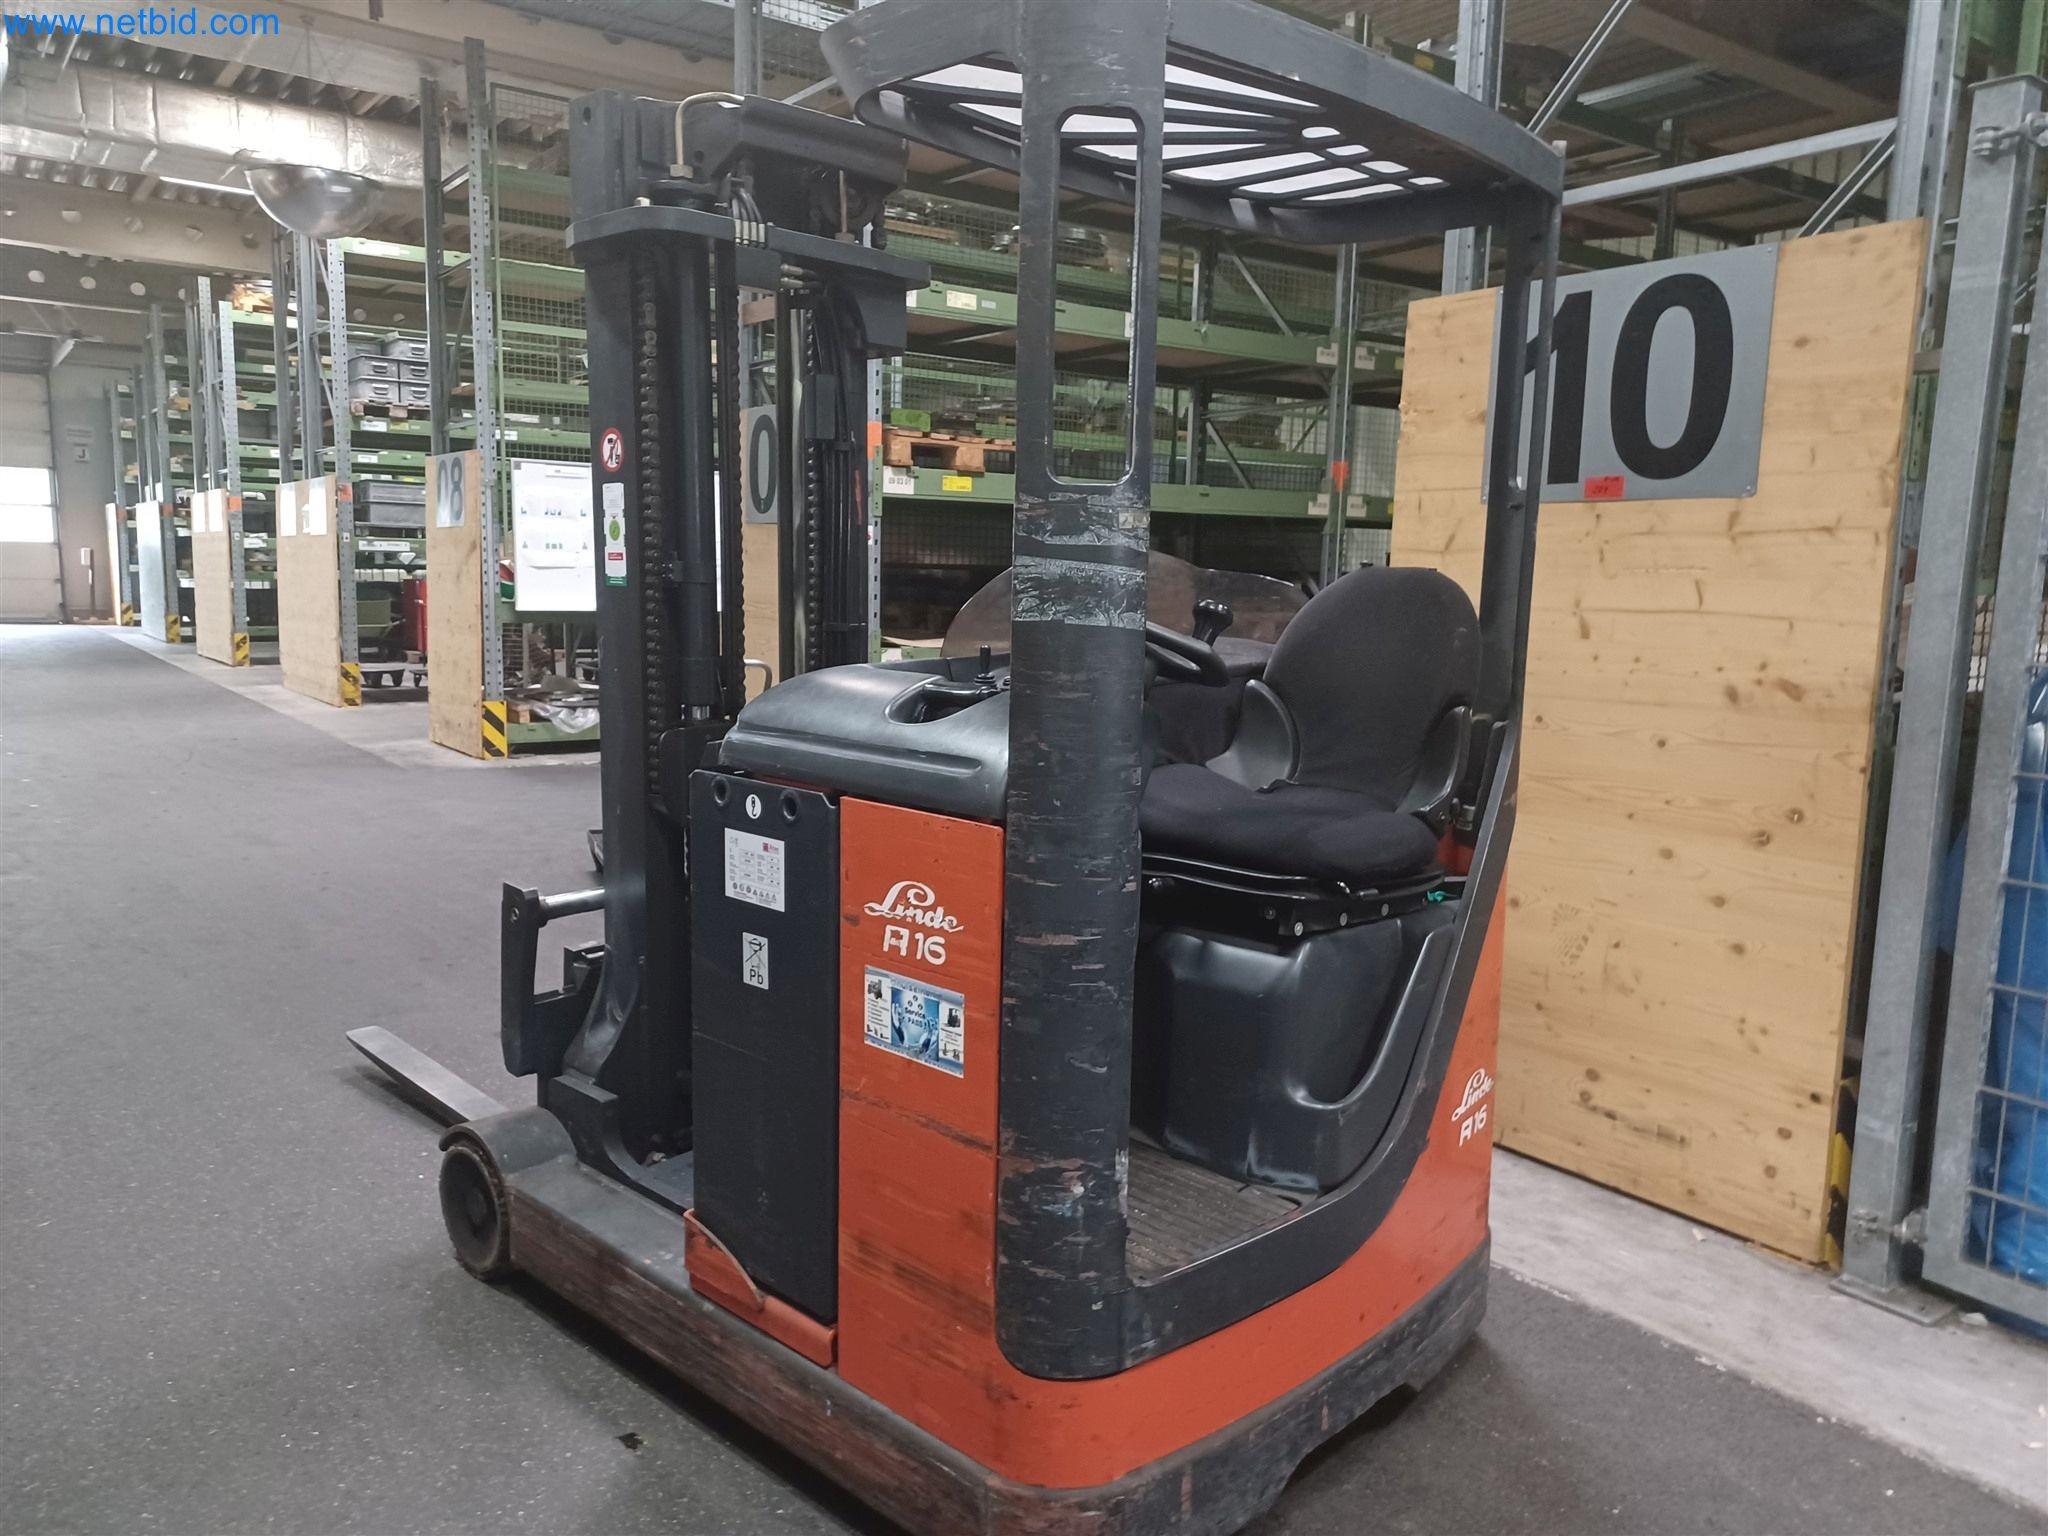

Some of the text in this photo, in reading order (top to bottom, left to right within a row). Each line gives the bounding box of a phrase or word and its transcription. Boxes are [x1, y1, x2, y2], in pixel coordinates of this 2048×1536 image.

[1524, 273, 1733, 484] 10
[863, 880, 964, 933] Linde
[749, 968, 764, 985] Pb
[1452, 1068, 1494, 1121] Linde
